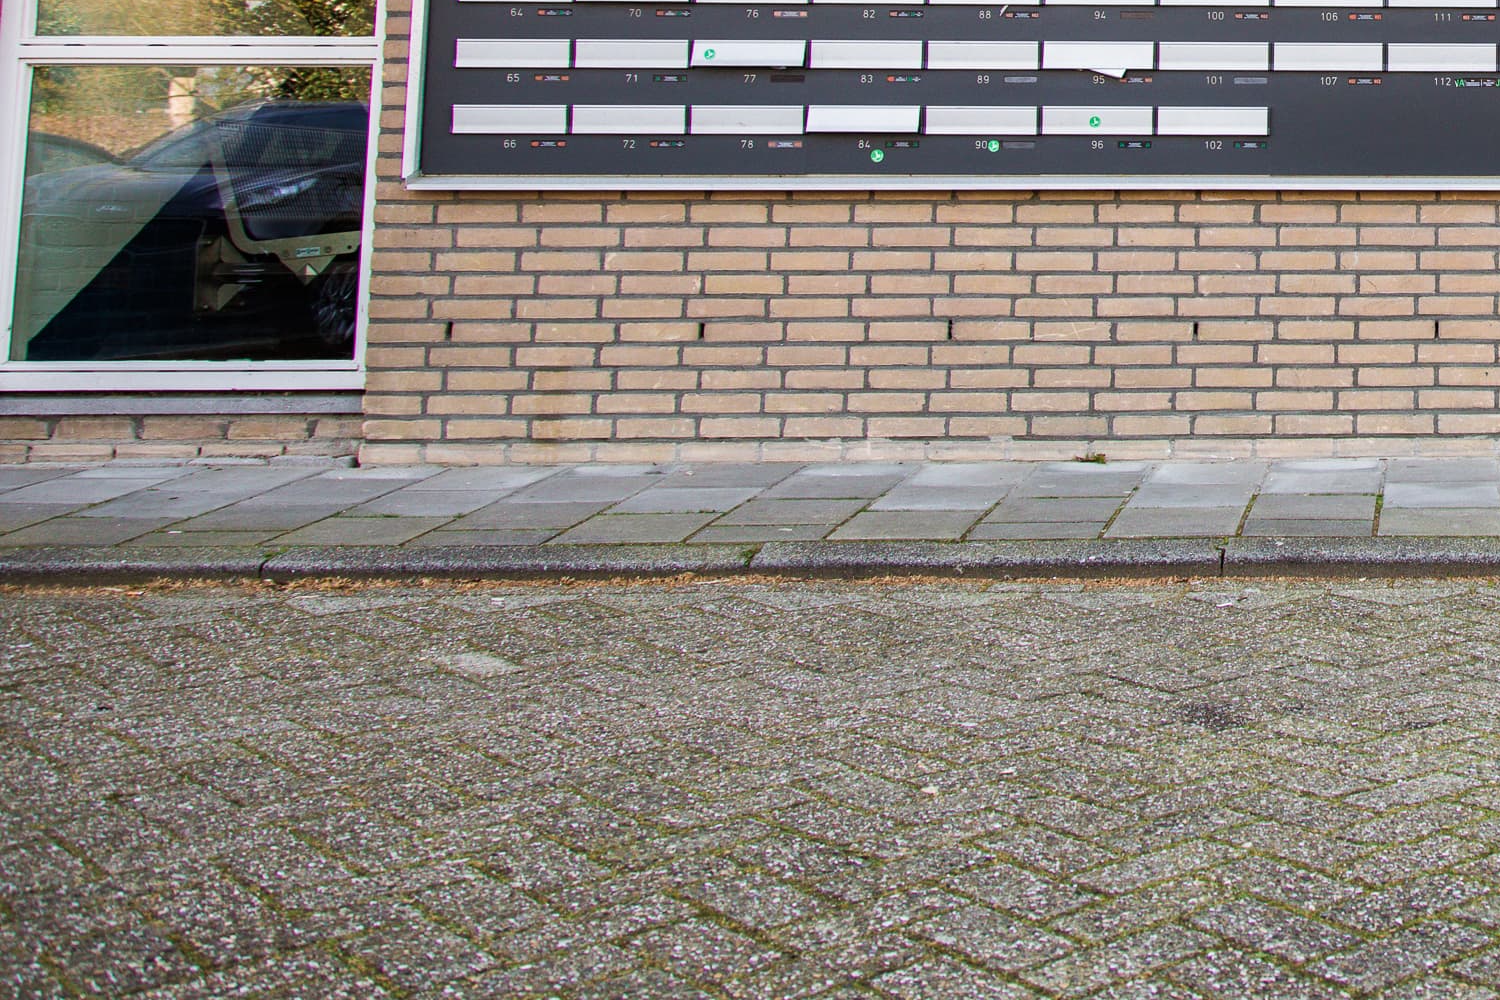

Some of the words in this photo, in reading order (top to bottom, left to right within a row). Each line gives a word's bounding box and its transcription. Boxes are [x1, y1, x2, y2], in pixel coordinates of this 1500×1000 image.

[510, 7, 524, 17] 64
[628, 8, 642, 18] 70
[746, 8, 760, 19] 76
[862, 9, 876, 19] 82
[978, 10, 992, 20] 88
[1094, 10, 1106, 20] 94
[1207, 11, 1225, 21] 100
[1321, 11, 1339, 22] 106
[1434, 12, 1451, 22] 111
[506, 73, 520, 83] 65
[625, 73, 638, 83] 71
[743, 74, 757, 83] 77
[860, 74, 873, 84] 83
[976, 74, 990, 85] 89
[1092, 75, 1105, 85] 95
[1206, 75, 1223, 85] 101
[1320, 76, 1338, 86] 107
[1434, 76, 1452, 87] 112
[503, 139, 517, 149] 66
[622, 139, 636, 149] 72
[740, 139, 754, 149] 78
[858, 139, 871, 149] 84
[974, 140, 988, 150] 90
[1091, 140, 1104, 150] 96
[1204, 140, 1223, 150] 102
